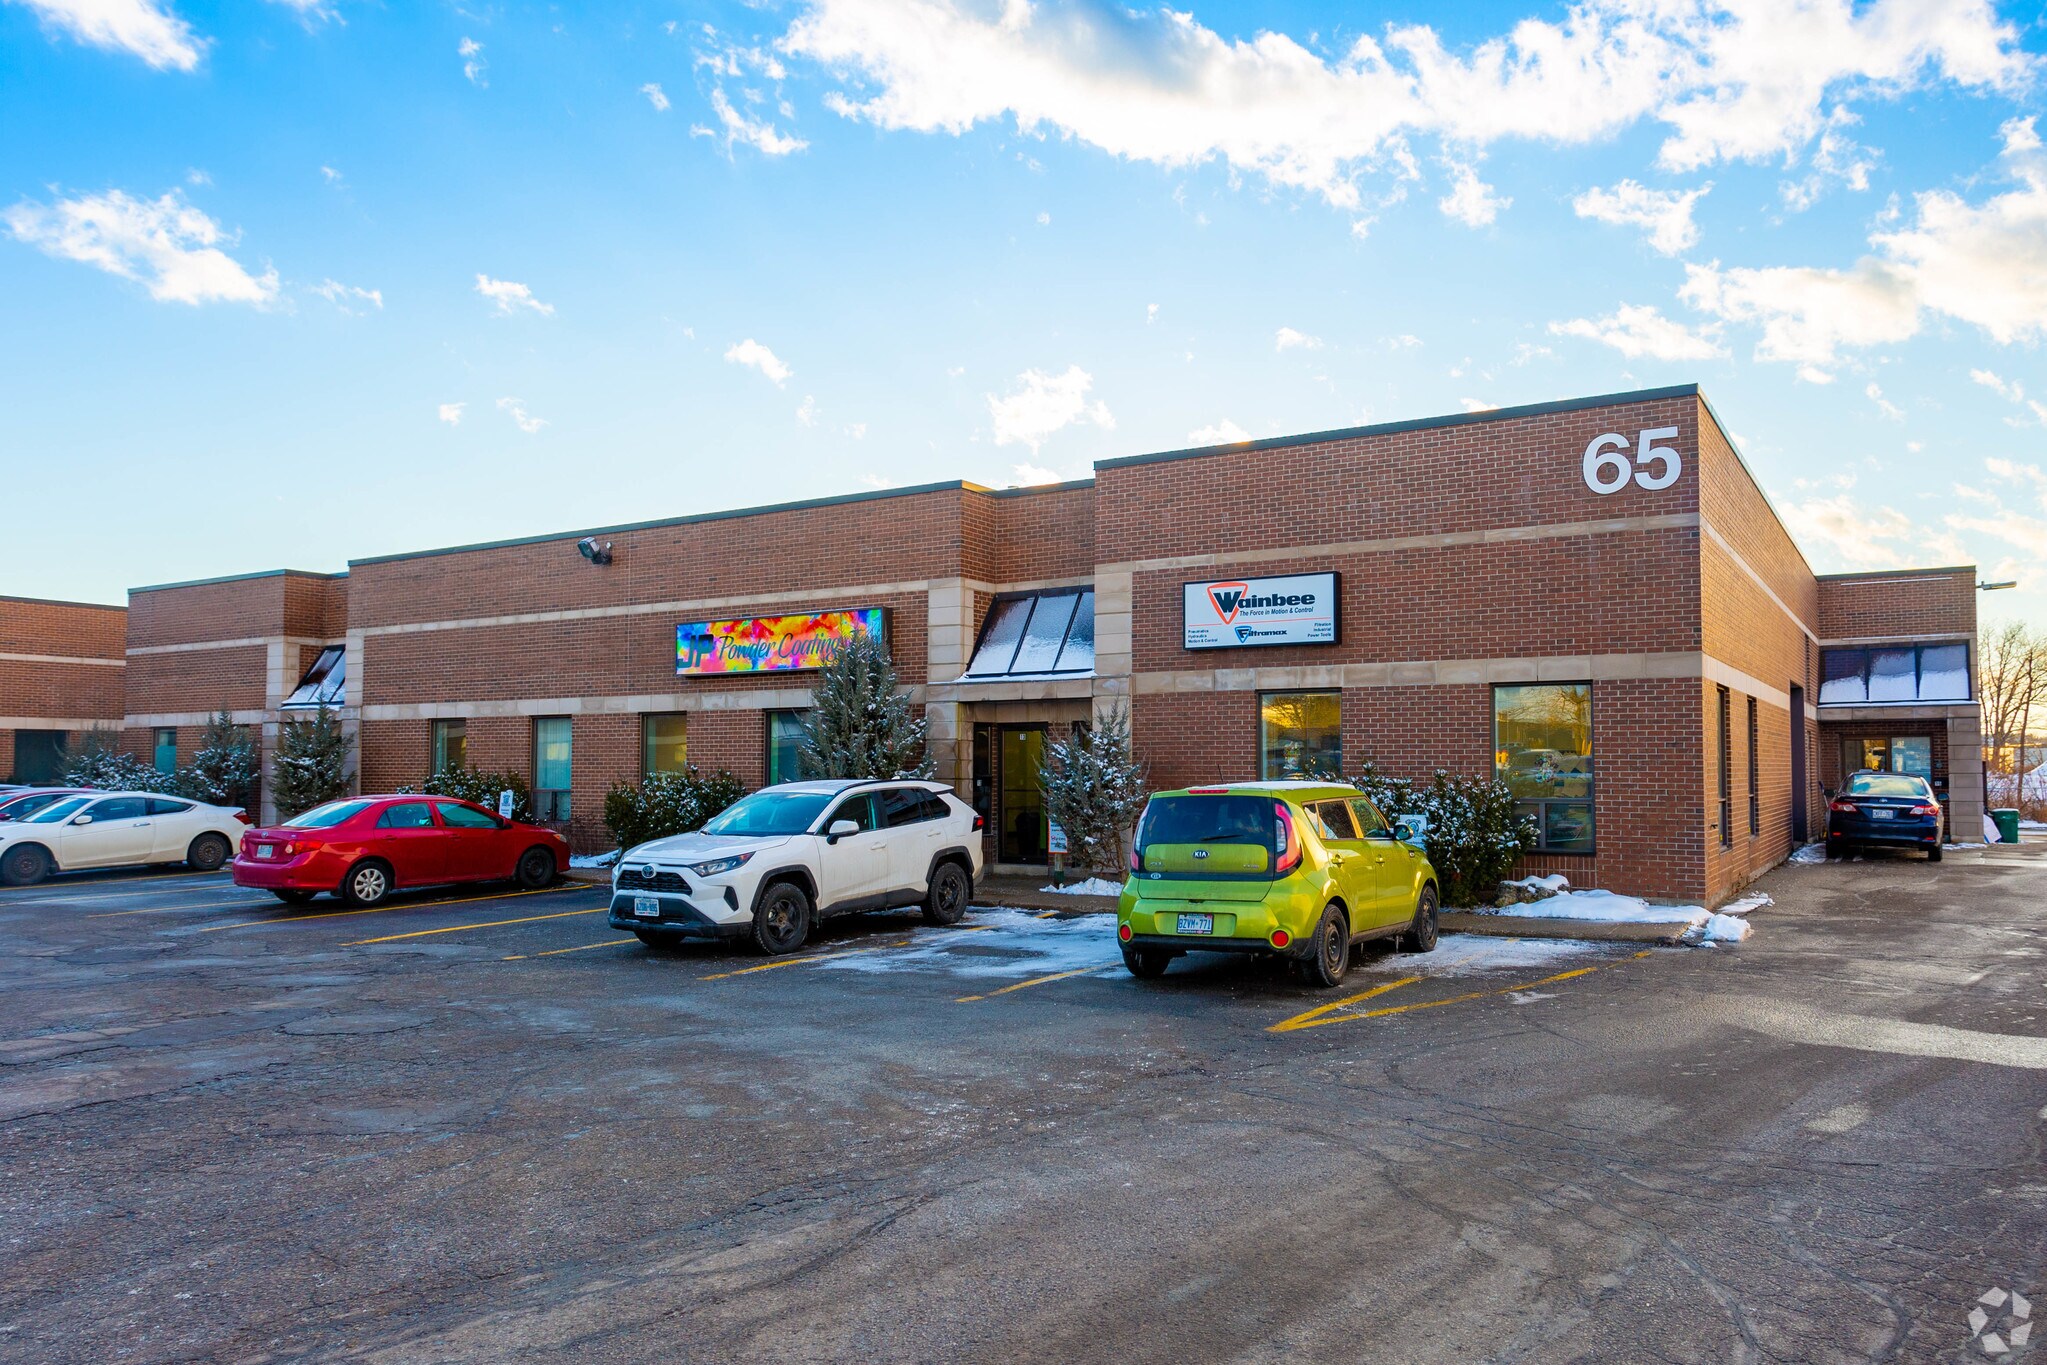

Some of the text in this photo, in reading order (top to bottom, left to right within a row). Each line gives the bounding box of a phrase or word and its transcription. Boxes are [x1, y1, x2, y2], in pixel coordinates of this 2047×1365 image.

[1583, 426, 1682, 495] 65
[1213, 590, 1316, 614] Wainbee
[1236, 628, 1288, 638] Filtramax
[678, 633, 714, 669] JP
[718, 635, 776, 661] Powder
